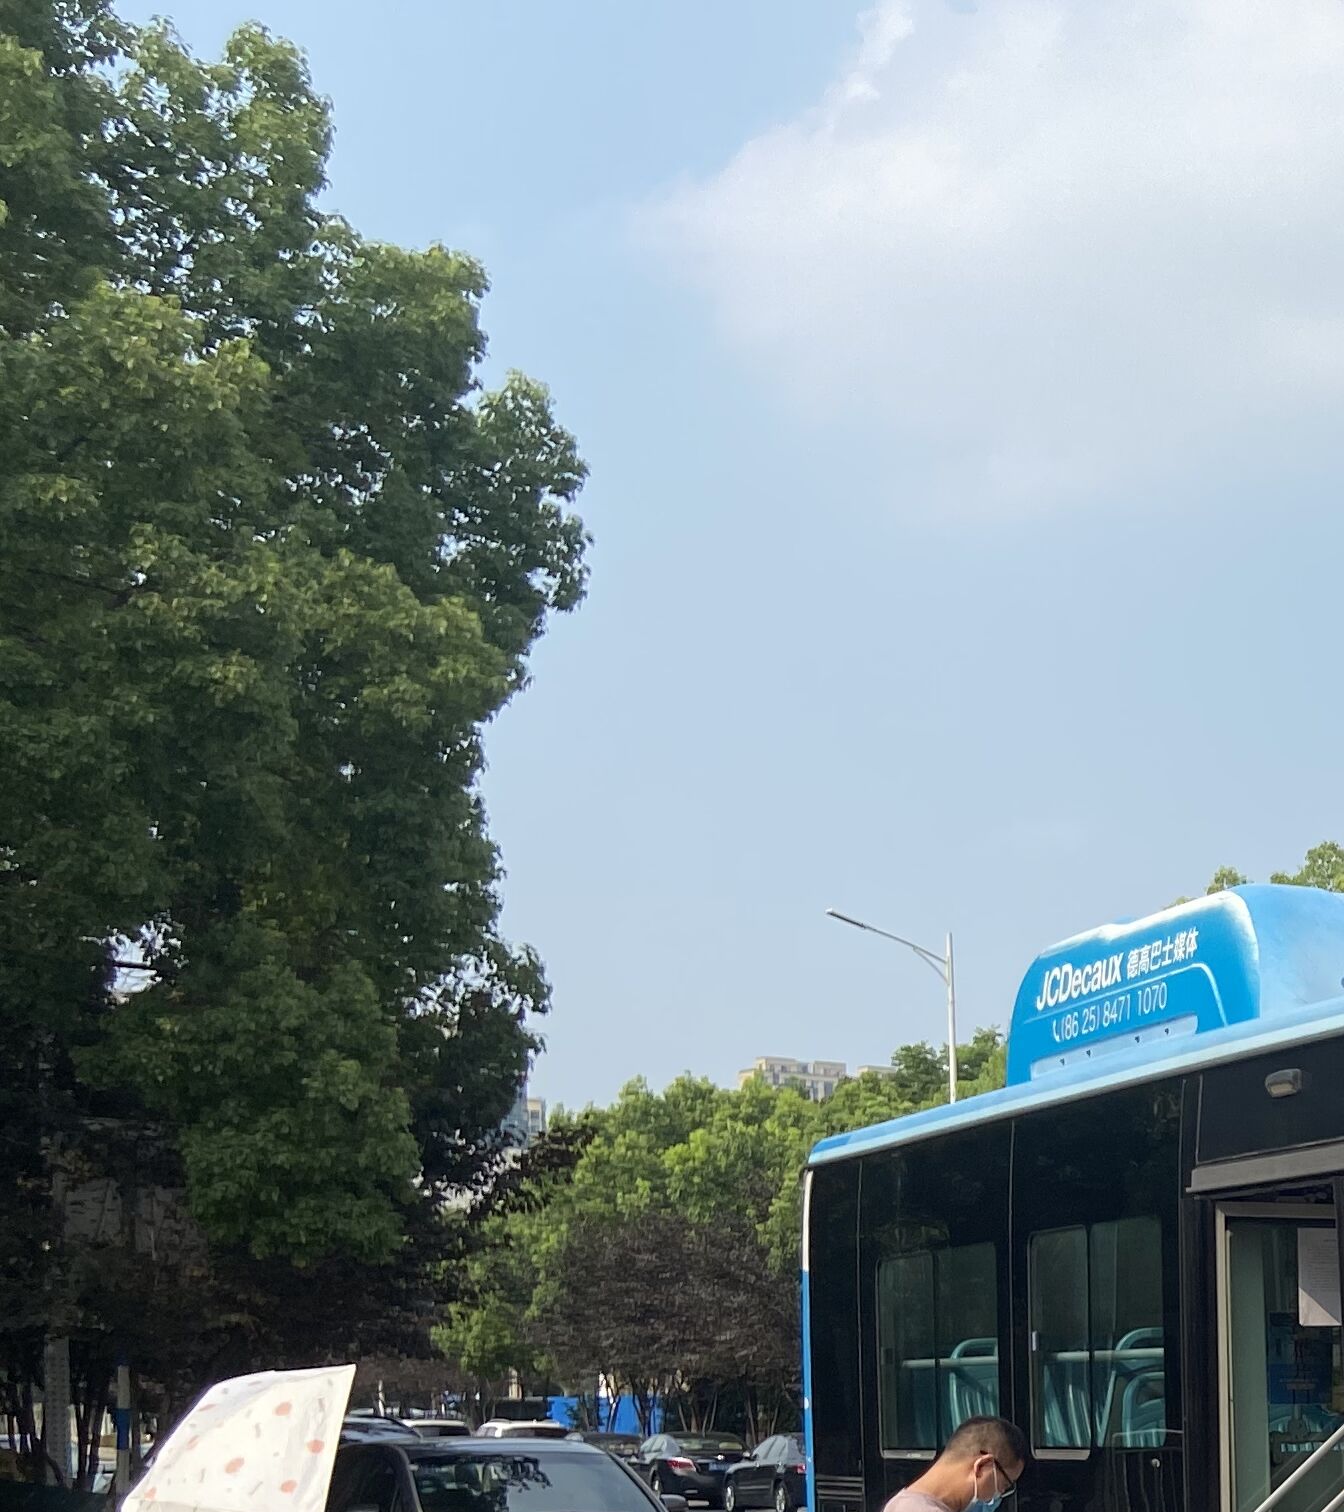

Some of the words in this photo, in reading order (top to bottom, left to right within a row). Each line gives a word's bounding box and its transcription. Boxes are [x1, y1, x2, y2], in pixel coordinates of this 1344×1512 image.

[1036, 952, 1125, 1011] JCDecaux
[1126, 926, 1199, 979] 德高巴士媒体
[1103, 993, 1131, 1027] 8471
[1138, 981, 1167, 1016] 1070
